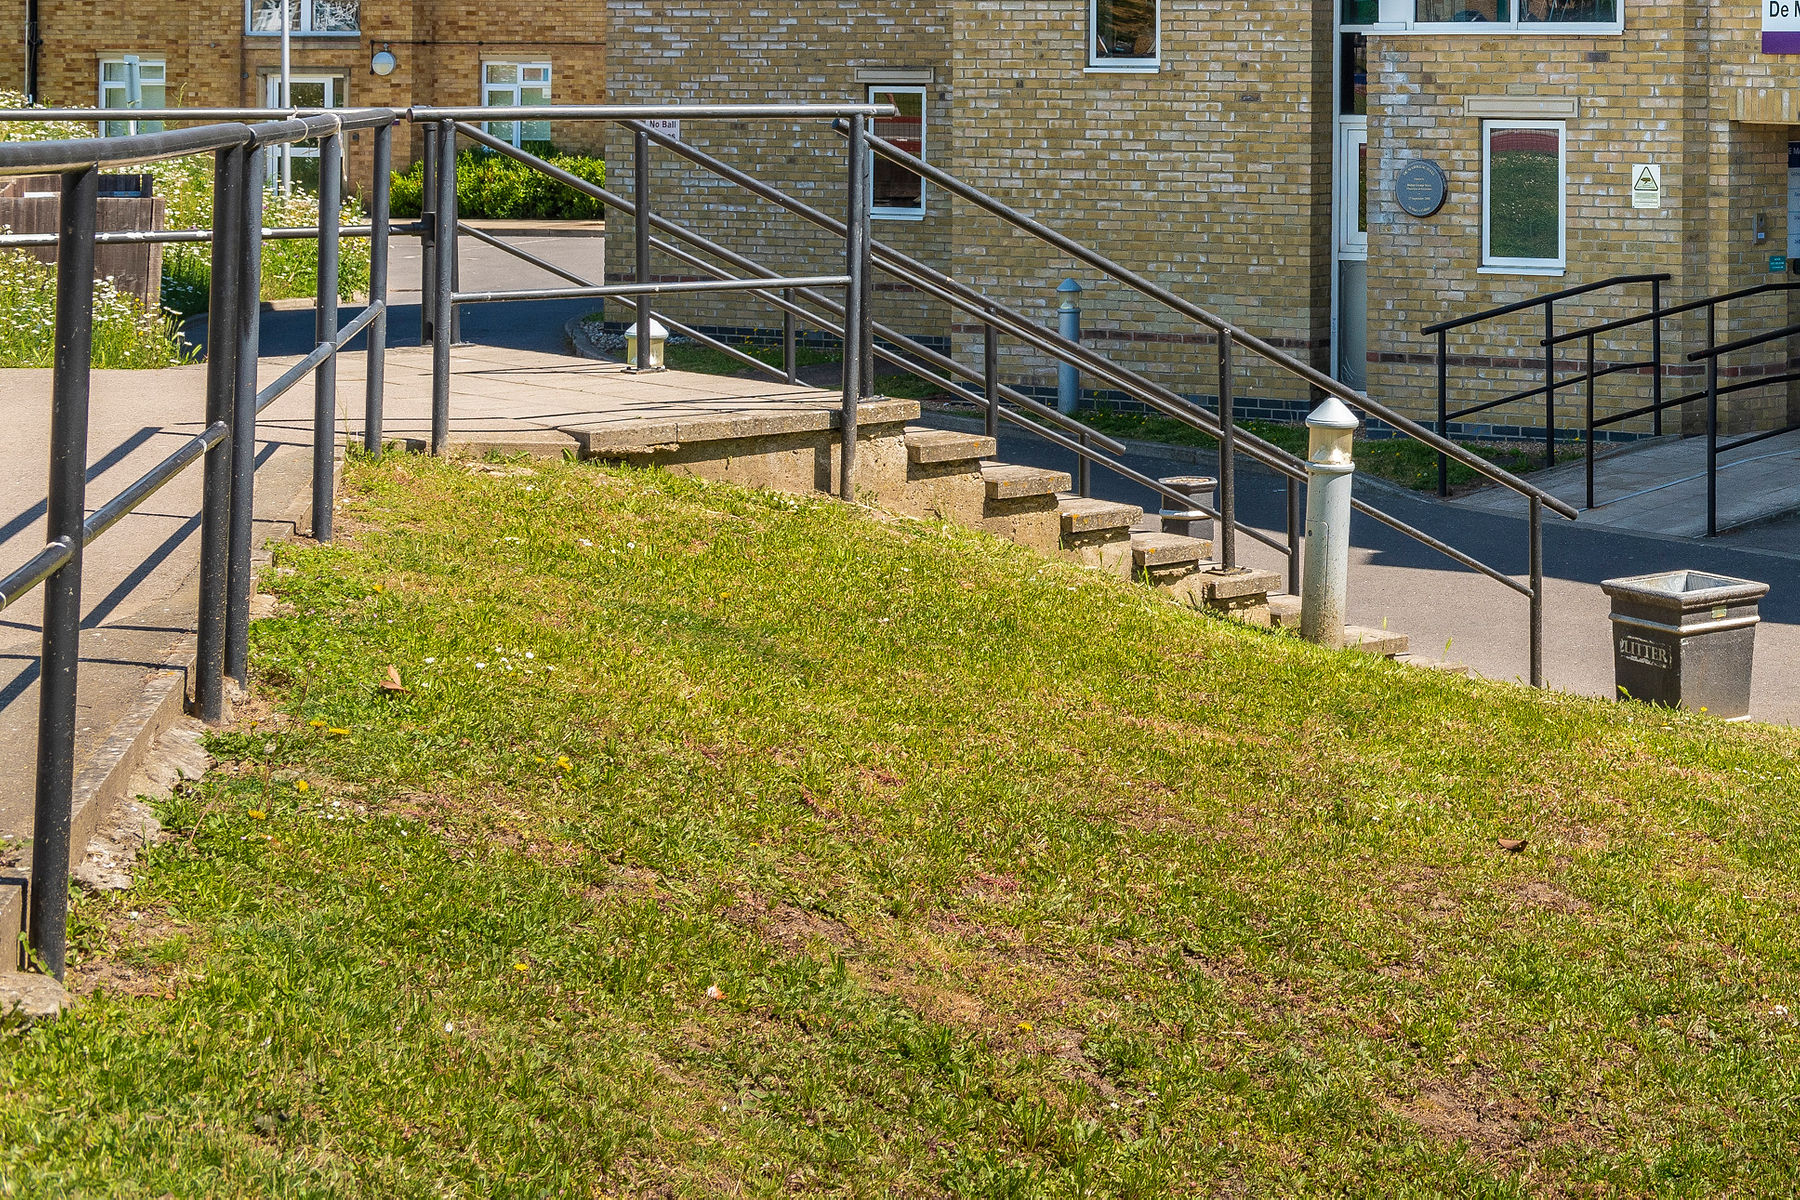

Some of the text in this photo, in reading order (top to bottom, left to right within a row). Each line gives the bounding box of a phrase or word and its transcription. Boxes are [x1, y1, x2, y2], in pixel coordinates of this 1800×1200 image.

[1769, 0, 1789, 18] De
[650, 120, 677, 128] No Ball
[1624, 640, 1668, 663] LITTER
